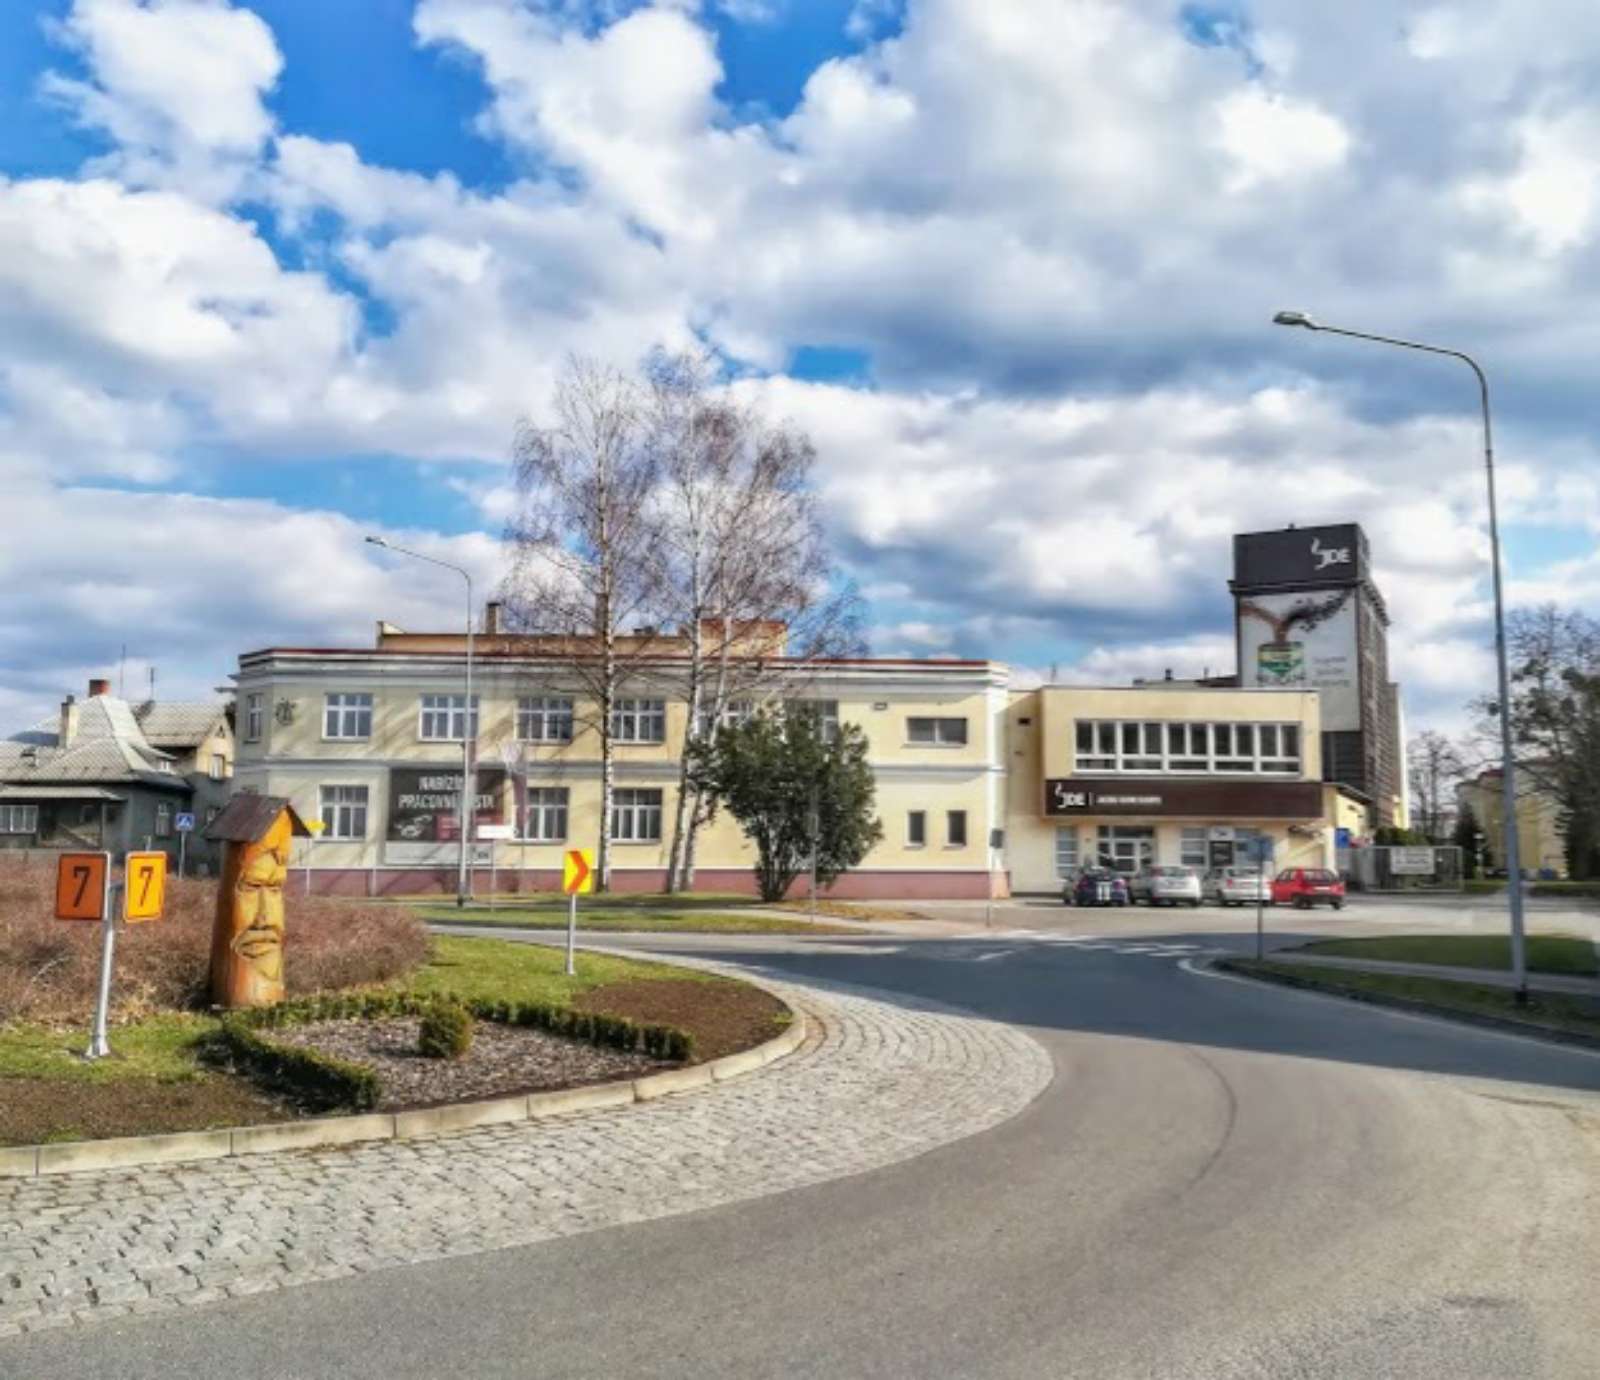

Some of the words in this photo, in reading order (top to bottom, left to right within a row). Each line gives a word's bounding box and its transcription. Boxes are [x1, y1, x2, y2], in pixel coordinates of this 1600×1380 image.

[1314, 545, 1351, 570] JDE
[73, 865, 90, 908] 7
[140, 865, 154, 908] 7
